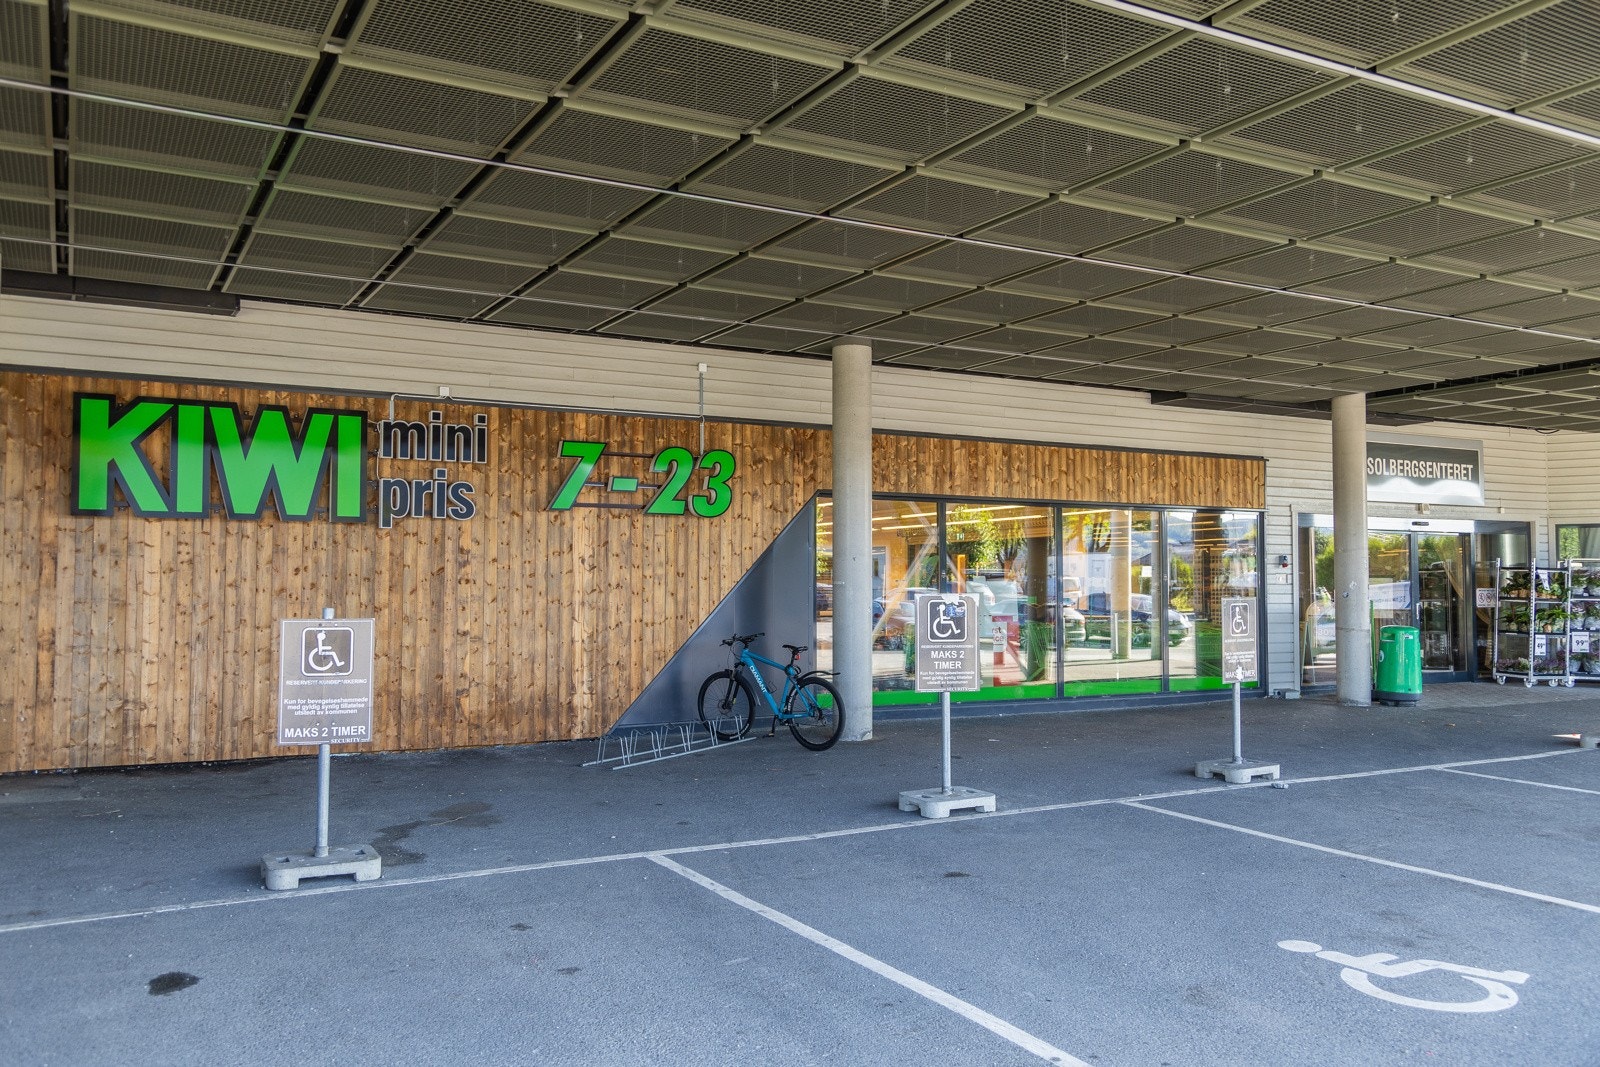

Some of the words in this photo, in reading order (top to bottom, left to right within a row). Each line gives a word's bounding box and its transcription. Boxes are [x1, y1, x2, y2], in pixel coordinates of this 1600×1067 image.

[381, 410, 488, 464] mini
[71, 391, 368, 523] KIWI
[1367, 457, 1474, 480] SOLBERGSENTERET
[378, 468, 477, 529] pris
[930, 650, 957, 659] MAKS
[959, 650, 965, 659] 2
[933, 661, 962, 670] TIMER
[321, 703, 340, 711] synlig
[284, 727, 319, 738] MAKS
[321, 727, 329, 737] 2
[331, 725, 366, 737] TIMER
